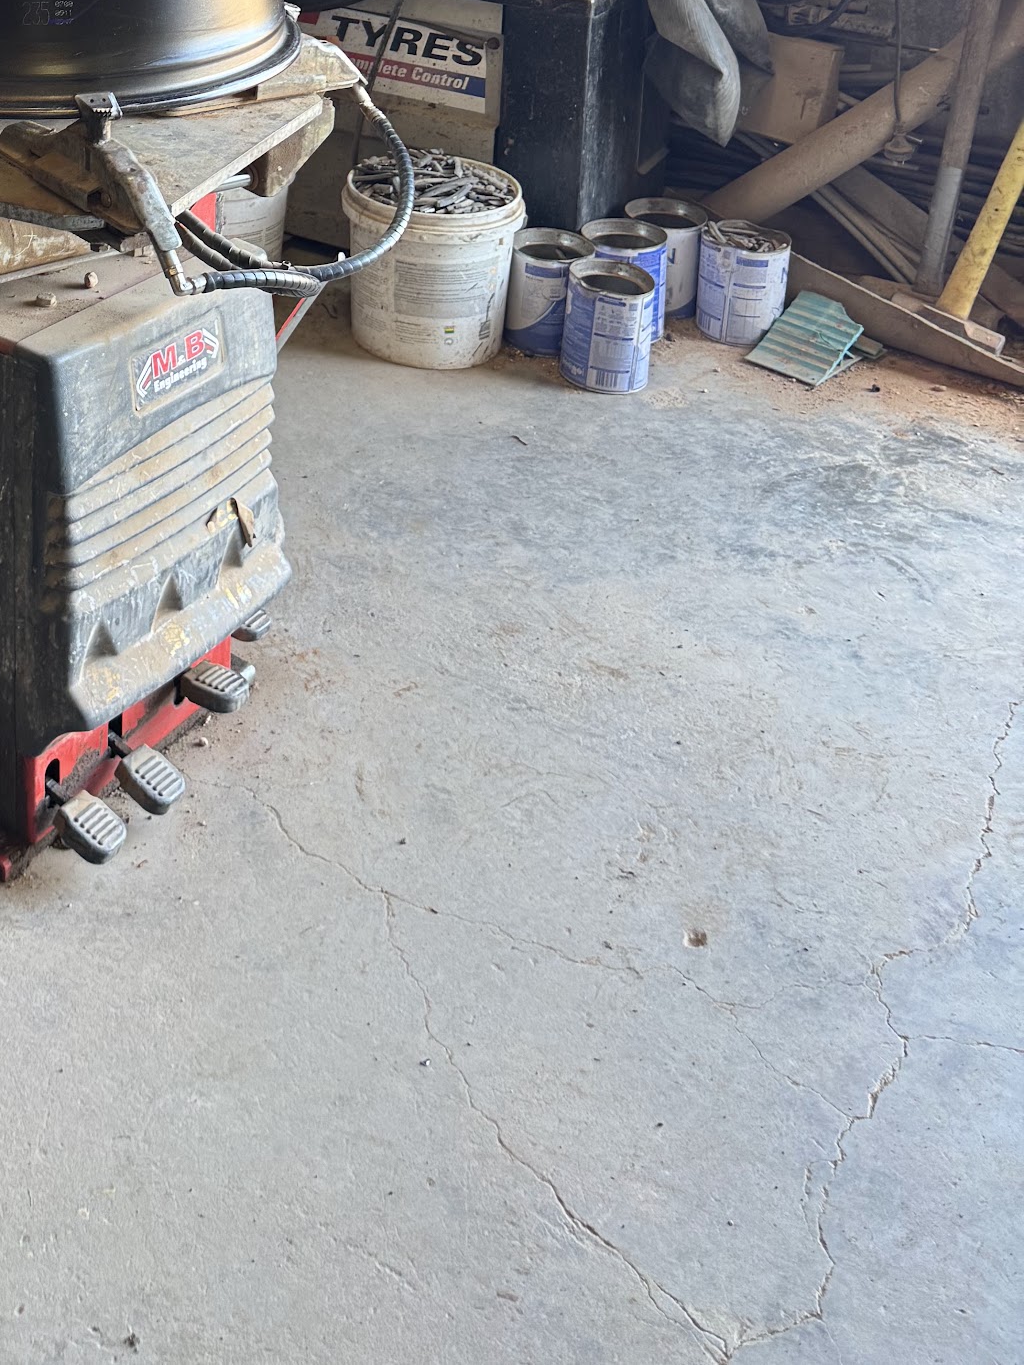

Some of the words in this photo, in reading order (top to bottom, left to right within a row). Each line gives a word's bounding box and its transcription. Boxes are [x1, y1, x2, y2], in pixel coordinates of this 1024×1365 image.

[22, 1, 51, 26] 235
[331, 15, 485, 68] TYRES
[350, 56, 407, 79] omplete
[411, 66, 470, 91] Control
[151, 329, 205, 380] M&B
[153, 356, 208, 394] Engineering
